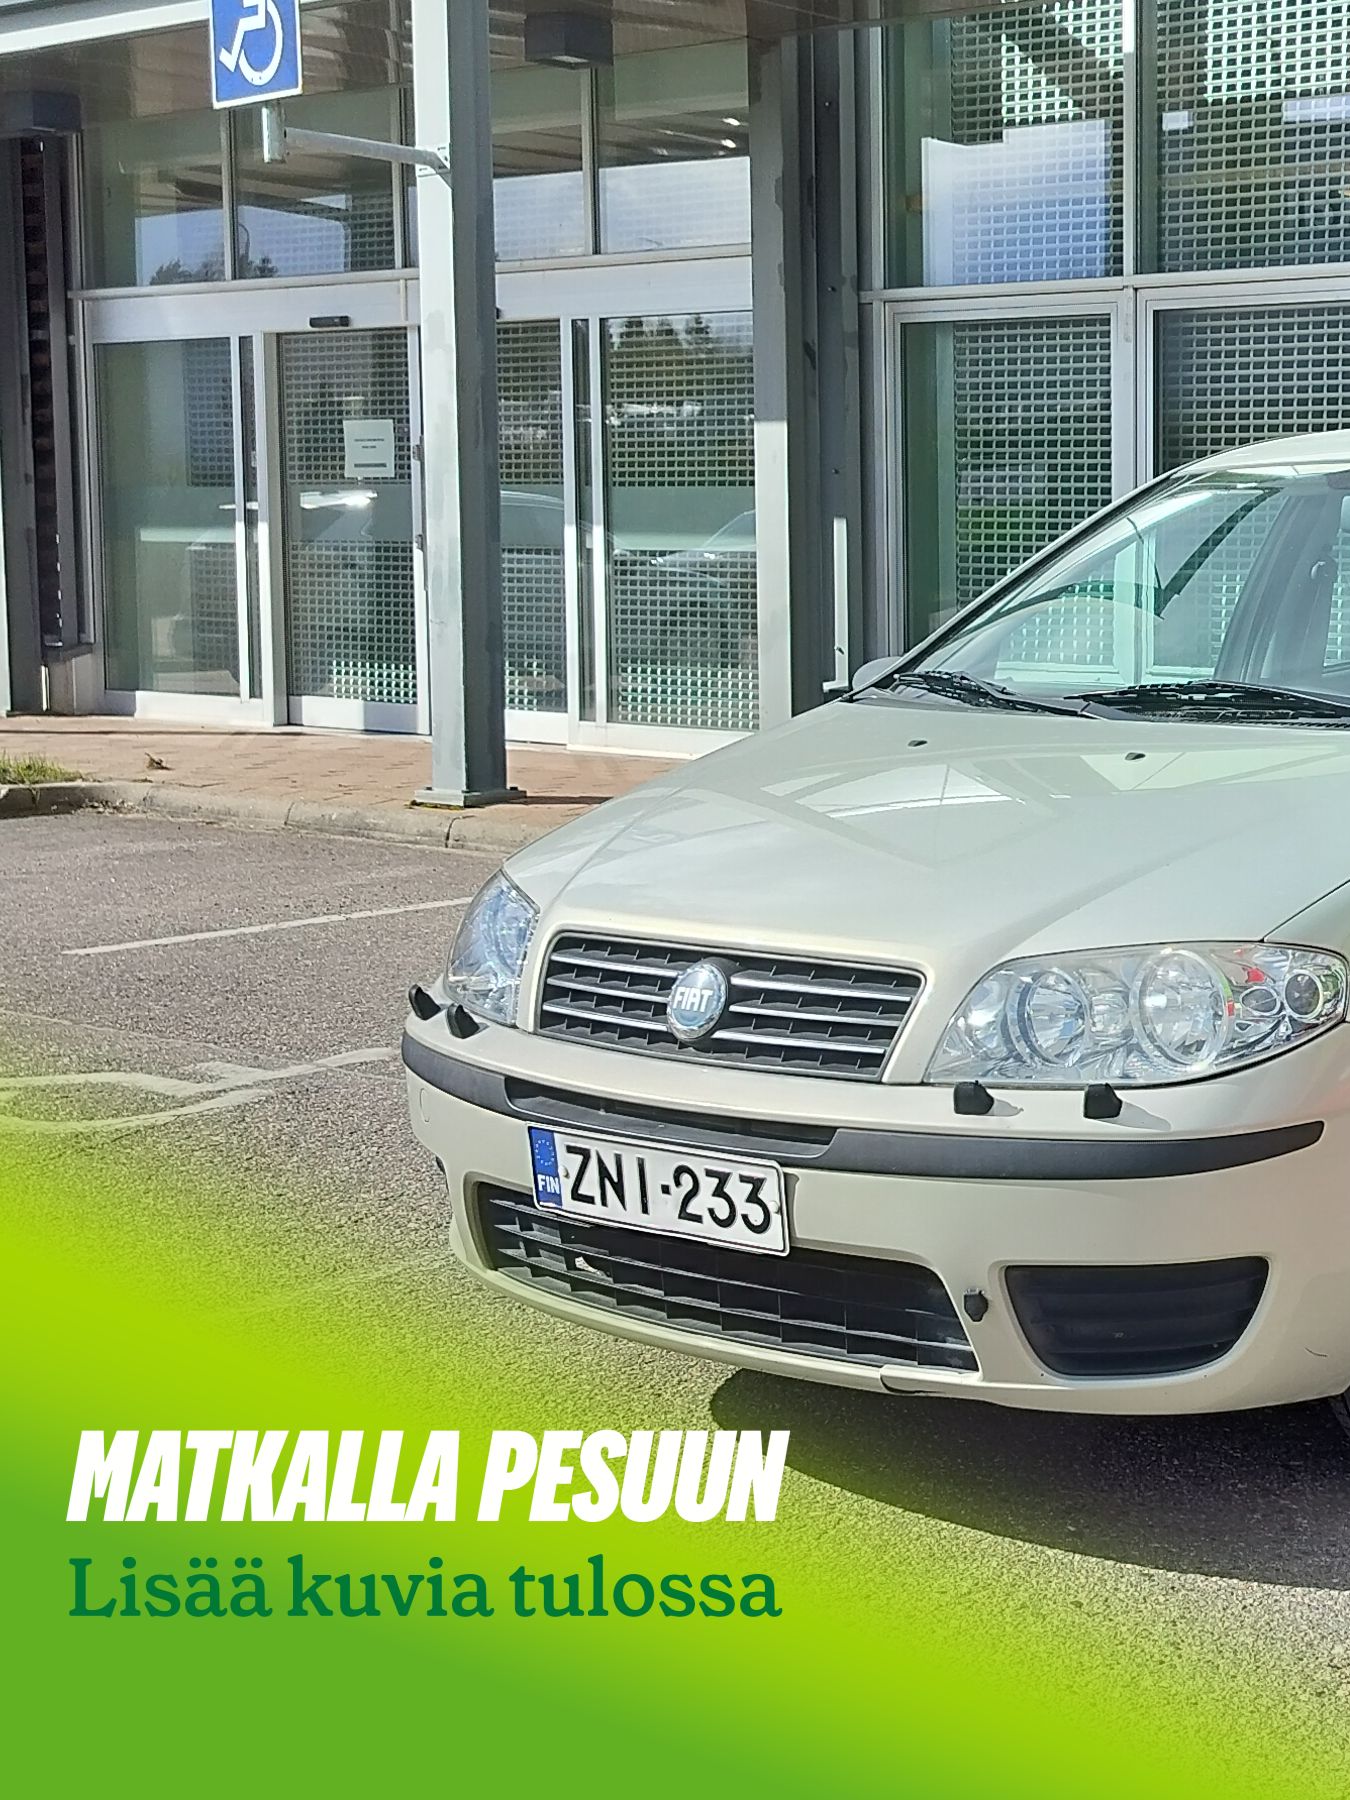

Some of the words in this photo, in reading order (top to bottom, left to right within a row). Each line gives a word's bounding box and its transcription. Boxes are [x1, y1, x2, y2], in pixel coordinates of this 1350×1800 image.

[672, 986, 713, 1013] FIAT
[537, 1173, 561, 1195] FIN
[565, 1144, 772, 1235] ZNI-233
